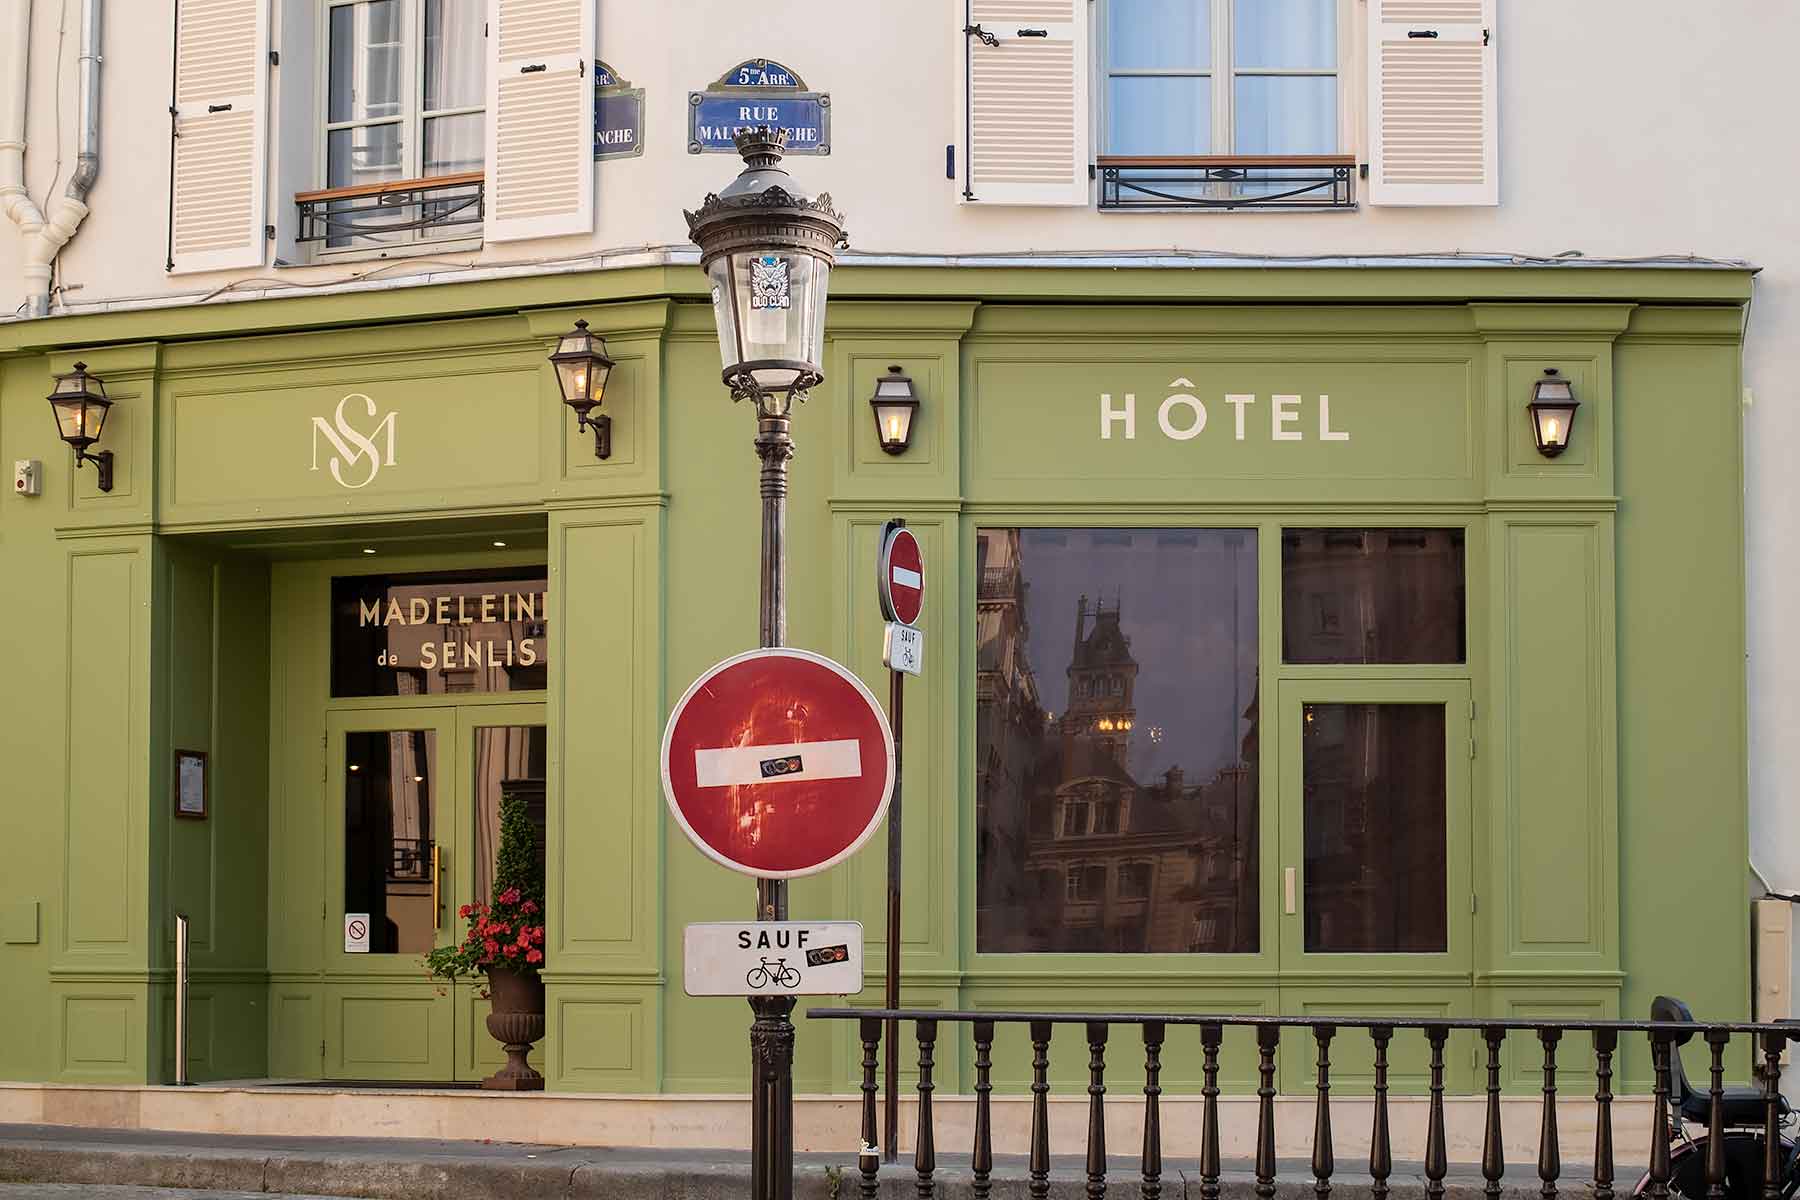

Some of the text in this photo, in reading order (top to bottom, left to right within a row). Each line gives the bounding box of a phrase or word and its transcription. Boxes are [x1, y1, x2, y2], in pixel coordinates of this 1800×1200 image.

[739, 106, 778, 121] RUE
[1099, 376, 1351, 442] HÔTEL
[901, 629, 915, 644] SAUF
[377, 638, 538, 670] de SENLIS
[738, 929, 810, 949] SAUF
